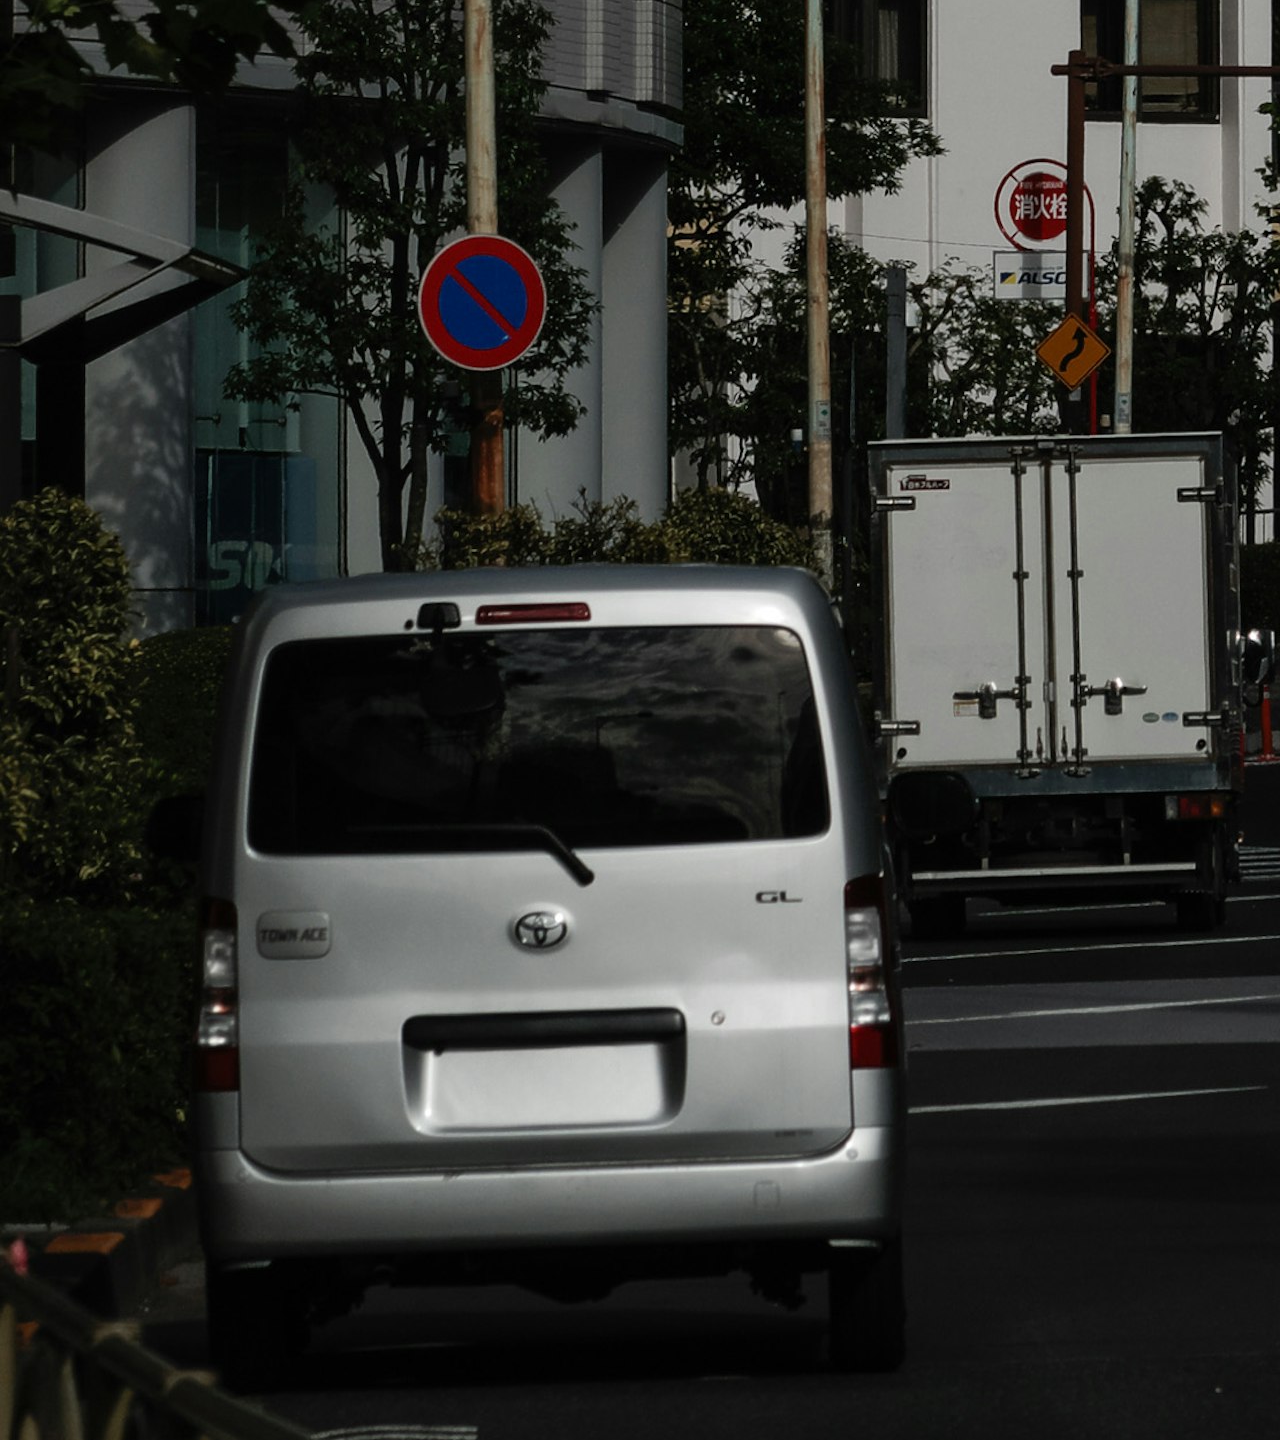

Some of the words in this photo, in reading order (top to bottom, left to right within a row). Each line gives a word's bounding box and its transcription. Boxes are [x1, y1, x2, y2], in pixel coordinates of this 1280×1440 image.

[1014, 192, 1067, 220] 消火栓
[1018, 271, 1067, 285] ALSO
[755, 890, 803, 904] GL
[260, 928, 298, 942] TOWN
[301, 927, 327, 941] ACE
